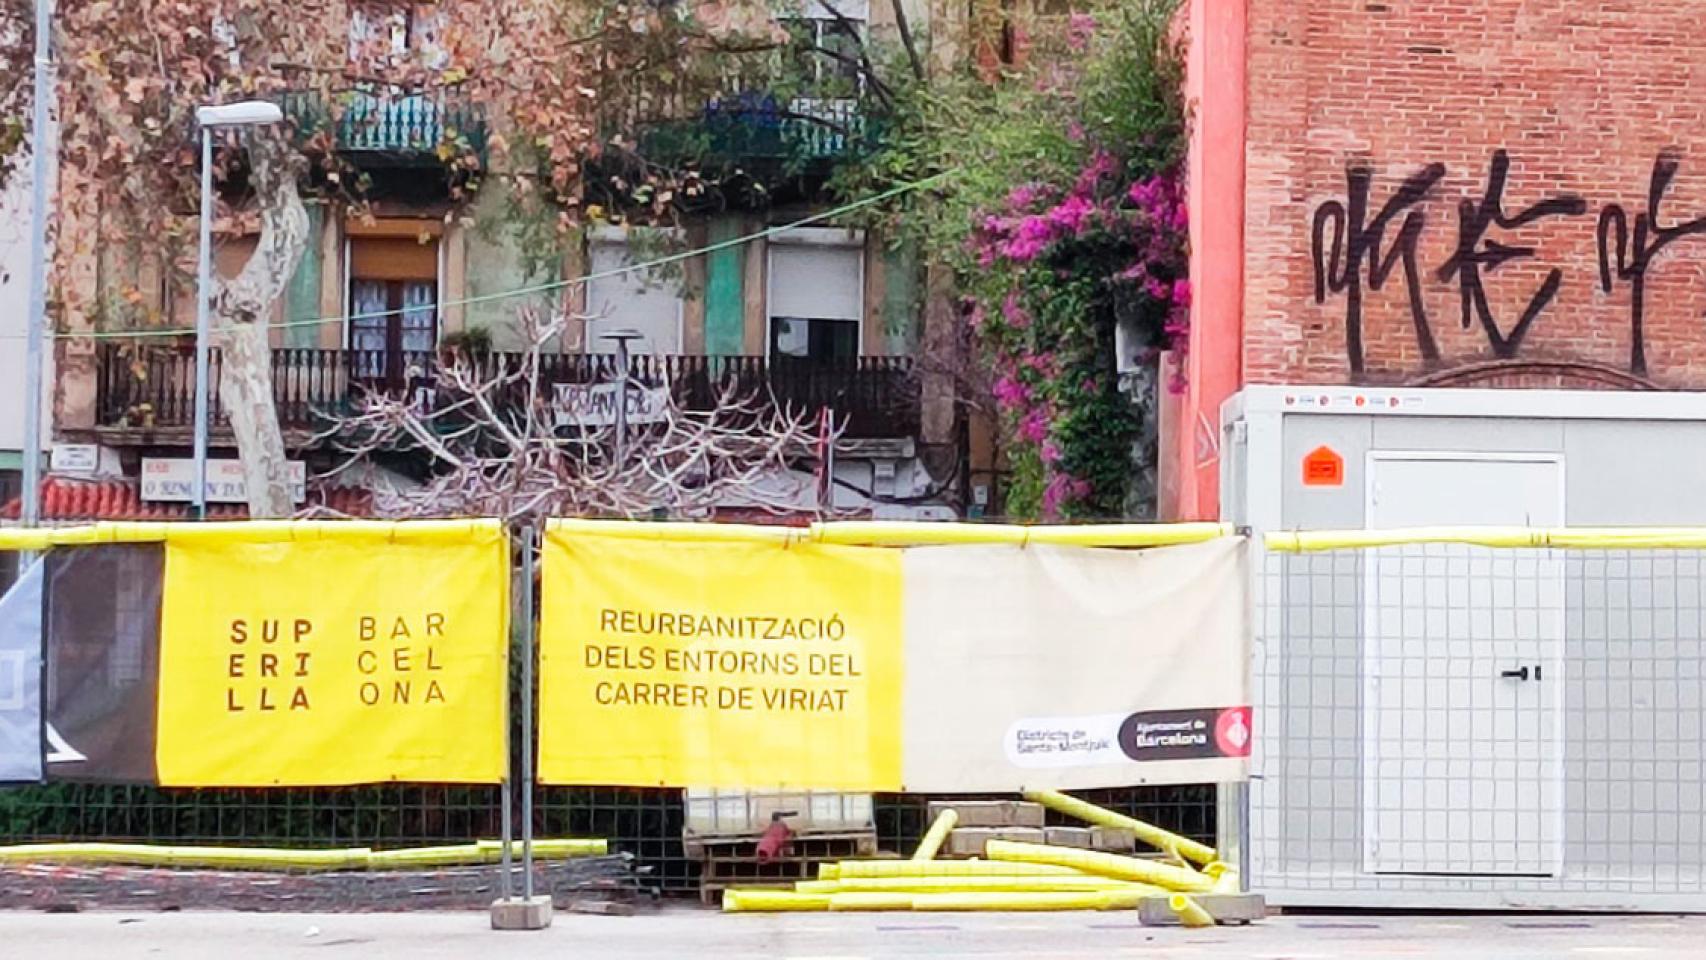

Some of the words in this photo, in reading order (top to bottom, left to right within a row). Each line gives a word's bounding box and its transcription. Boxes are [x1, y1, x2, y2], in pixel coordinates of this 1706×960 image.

[230, 619, 313, 645] SUP
[359, 612, 445, 641] BAR
[599, 608, 846, 642] REURBANITZACIÓ
[229, 652, 311, 678] ERI
[357, 645, 443, 675] CEL
[584, 645, 656, 670] DELS
[665, 649, 799, 676] ENTORNS
[809, 653, 862, 677] DEL
[227, 686, 310, 712] LLA
[359, 679, 446, 706] ONA
[595, 681, 709, 707] CARRER
[718, 686, 753, 711] DE
[762, 688, 849, 712] VIRIAT
[1136, 732, 1207, 748] Barcelona
